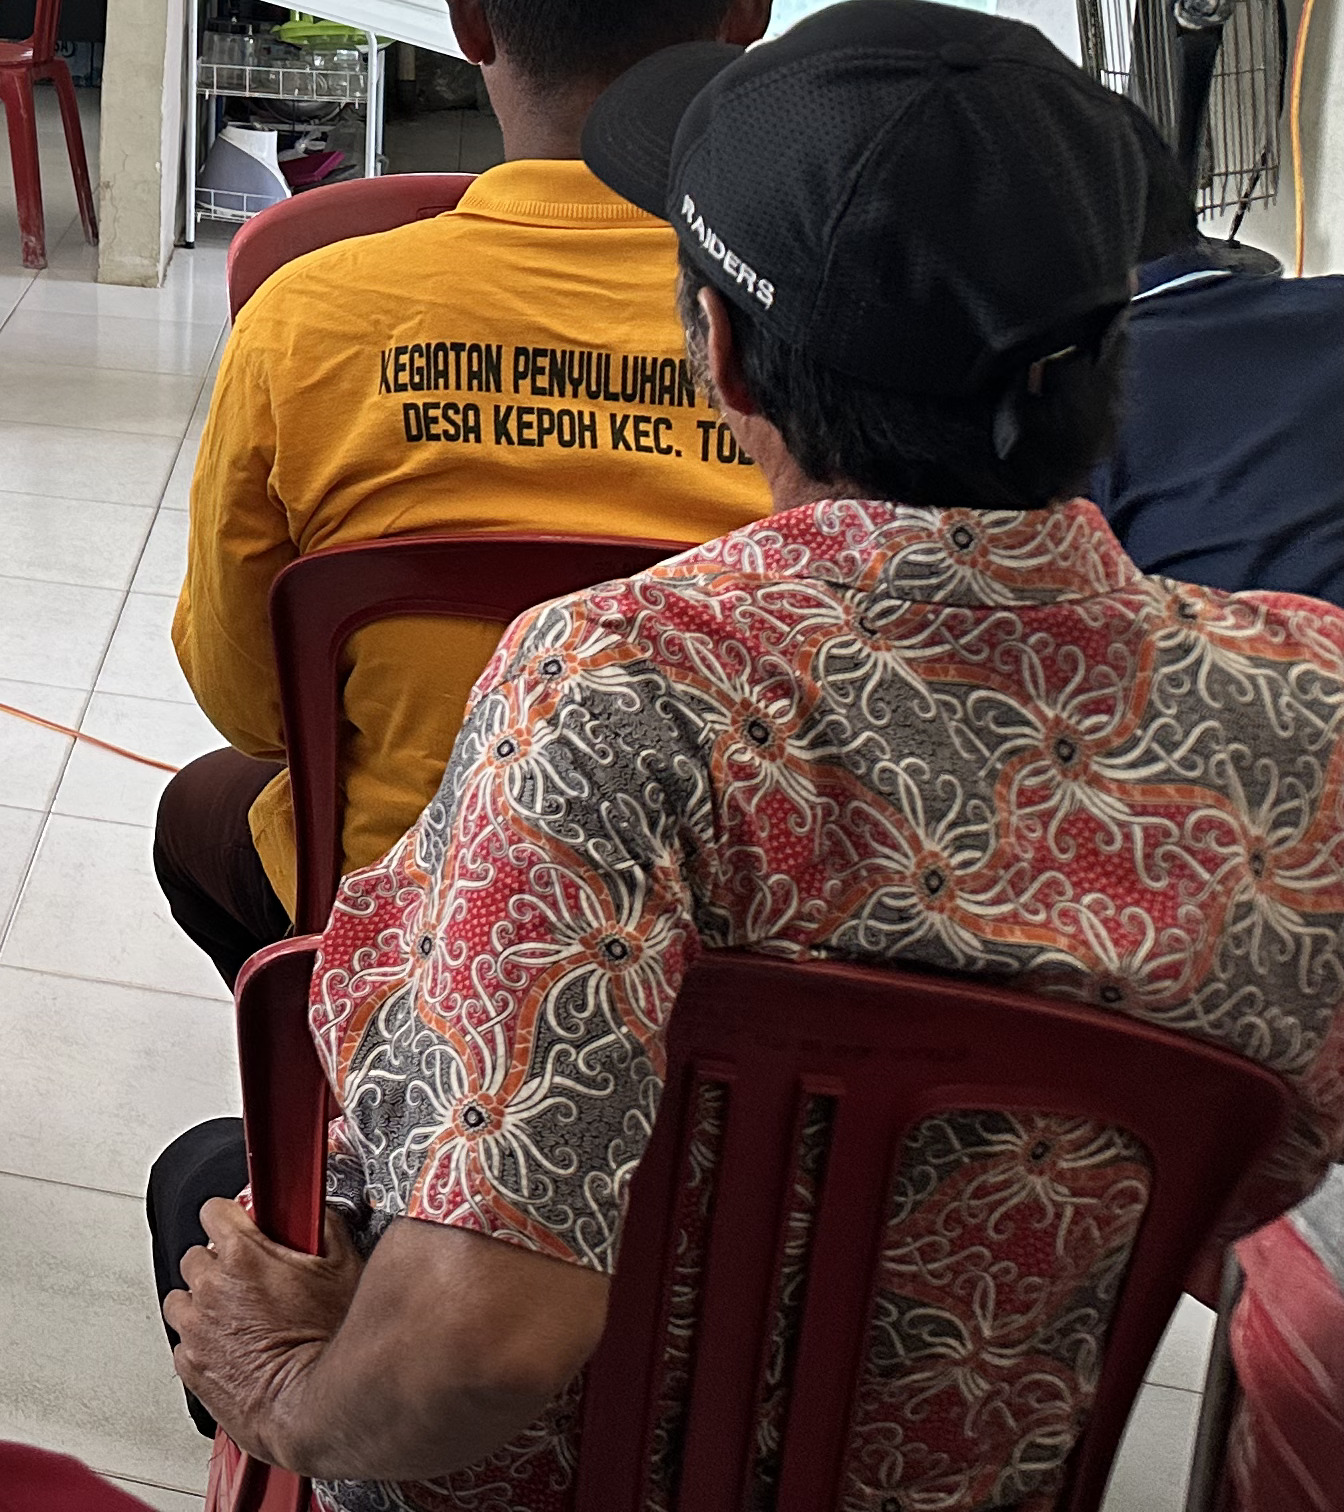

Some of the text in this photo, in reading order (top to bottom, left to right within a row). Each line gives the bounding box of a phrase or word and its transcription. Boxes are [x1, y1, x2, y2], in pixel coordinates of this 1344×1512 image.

[681, 194, 777, 310] RAIDERS
[378, 341, 697, 408] KEGIATAN PENYULUHAN
[402, 401, 482, 444] DESA
[492, 404, 598, 450] KEPOH
[609, 412, 683, 459] KEC.
